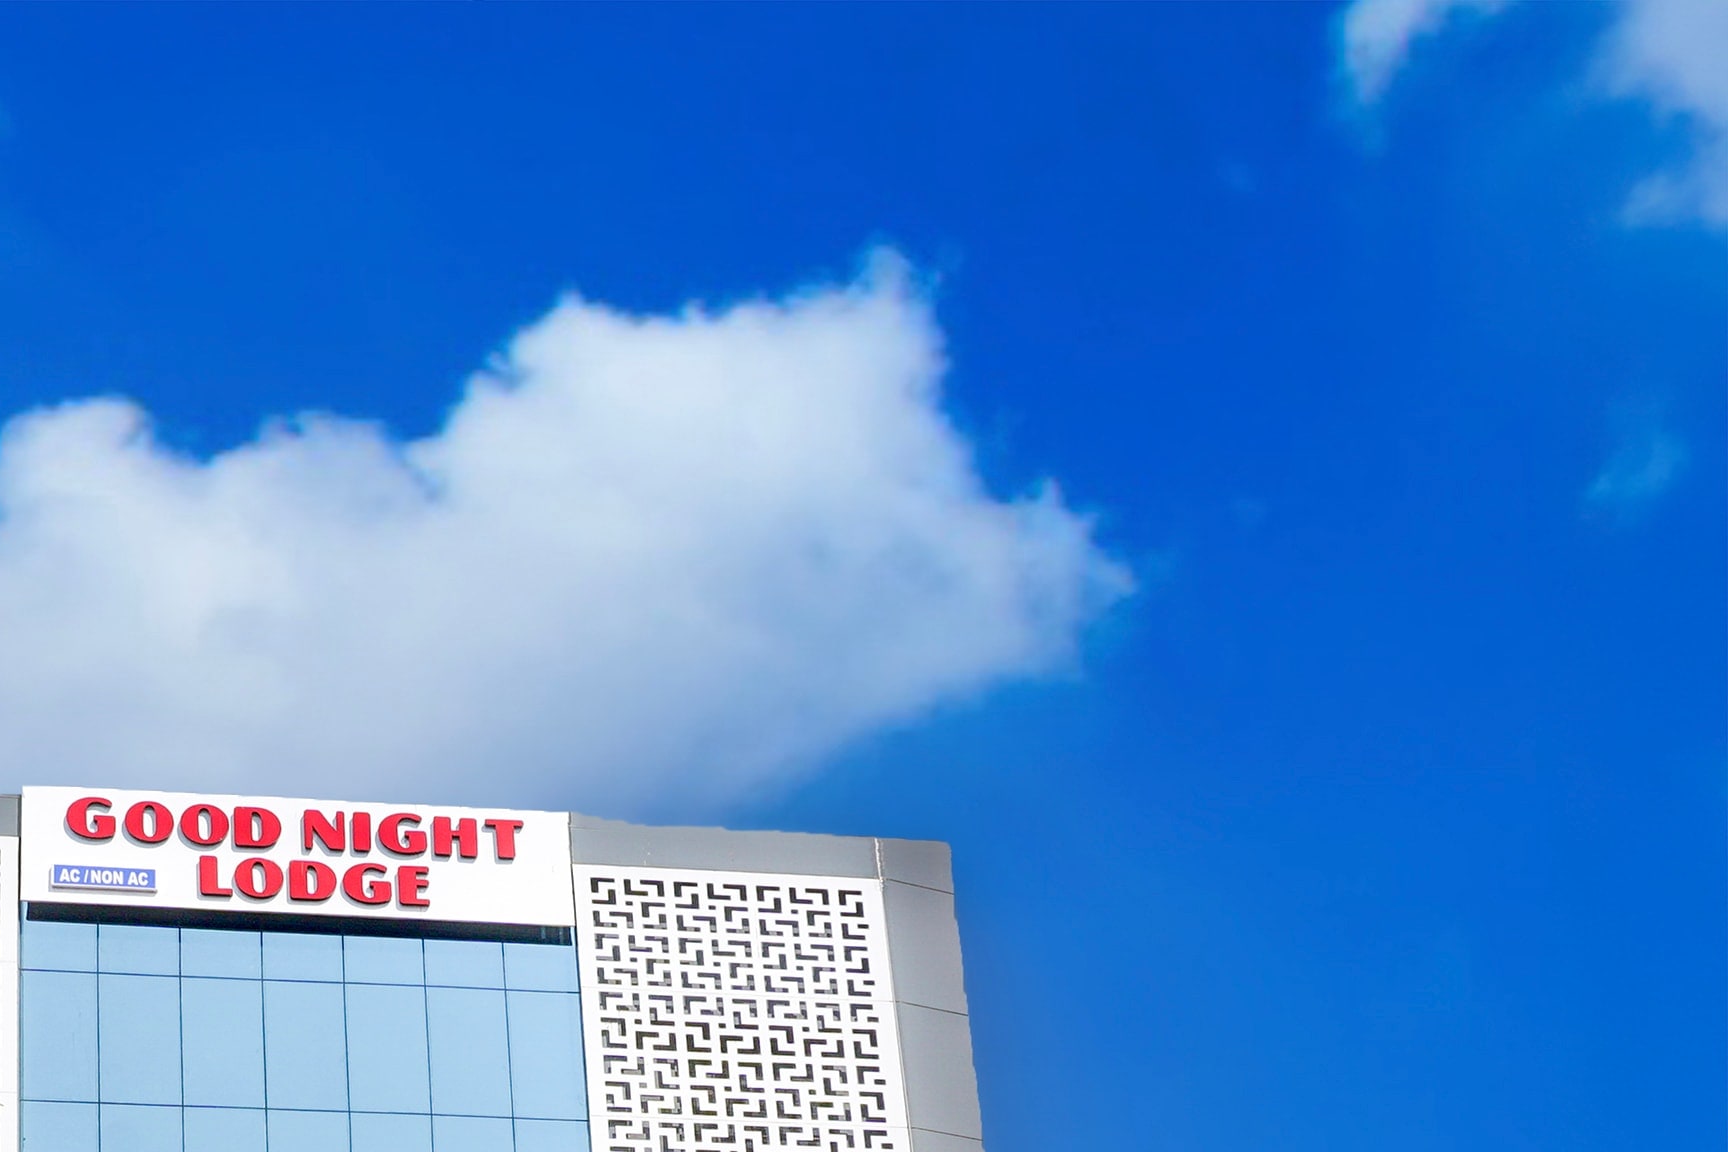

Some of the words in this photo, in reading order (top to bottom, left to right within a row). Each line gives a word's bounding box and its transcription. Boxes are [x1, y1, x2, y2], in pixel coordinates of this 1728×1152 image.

[66, 797, 282, 849] GOOD
[304, 809, 524, 860] NIGHT
[59, 868, 81, 883] AC
[90, 870, 124, 885] NON
[127, 872, 149, 886] AC
[198, 855, 430, 907] LODGE
